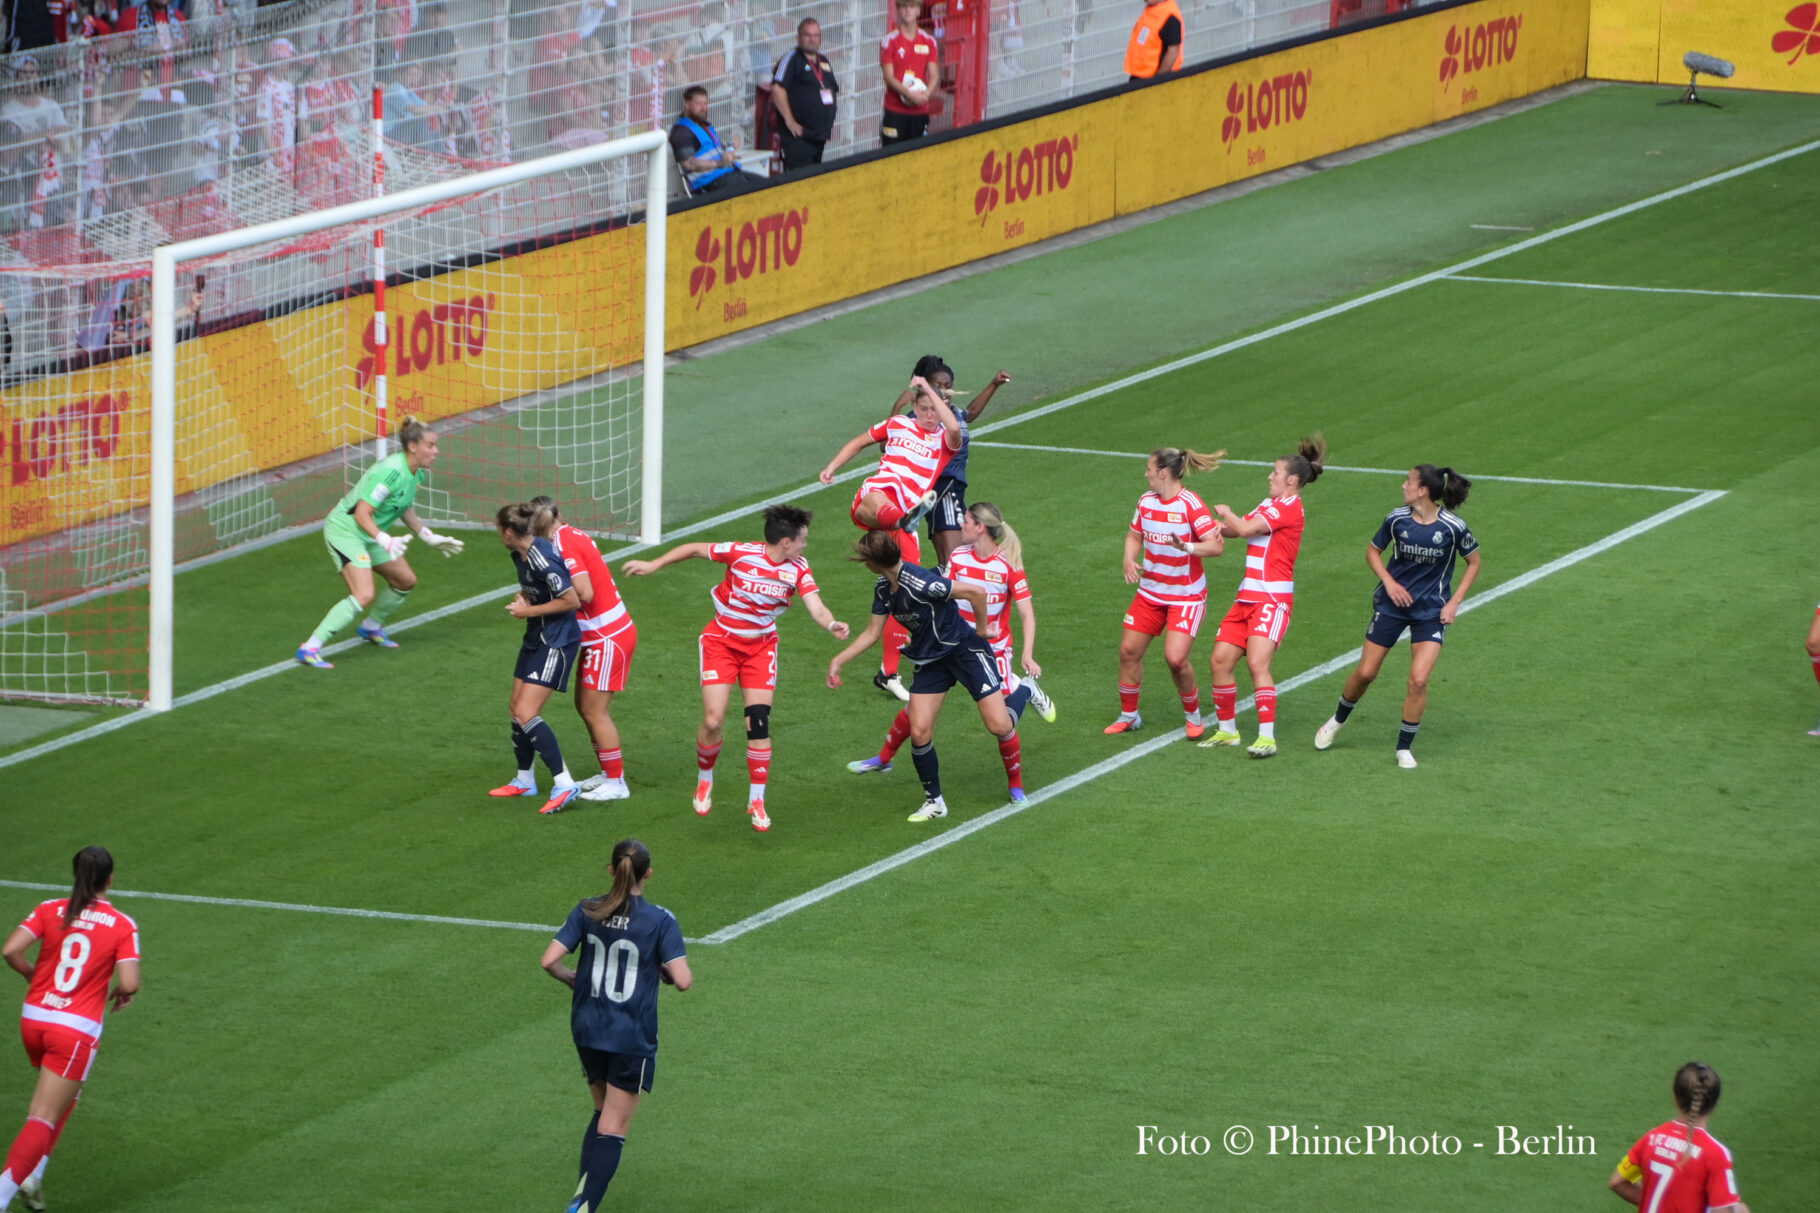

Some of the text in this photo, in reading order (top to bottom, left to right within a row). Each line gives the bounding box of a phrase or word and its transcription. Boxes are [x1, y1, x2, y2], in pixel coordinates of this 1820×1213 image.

[723, 297, 747, 322] Berlin
[899, 437, 933, 458] raisin
[1400, 541, 1445, 557] Emirates
[753, 582, 788, 598] raisin
[1260, 603, 1275, 623] 5
[584, 648, 602, 671] 31
[768, 651, 776, 674] 2
[54, 932, 92, 993] 8
[587, 933, 640, 1003] 10
[1648, 1160, 1674, 1213] 7
